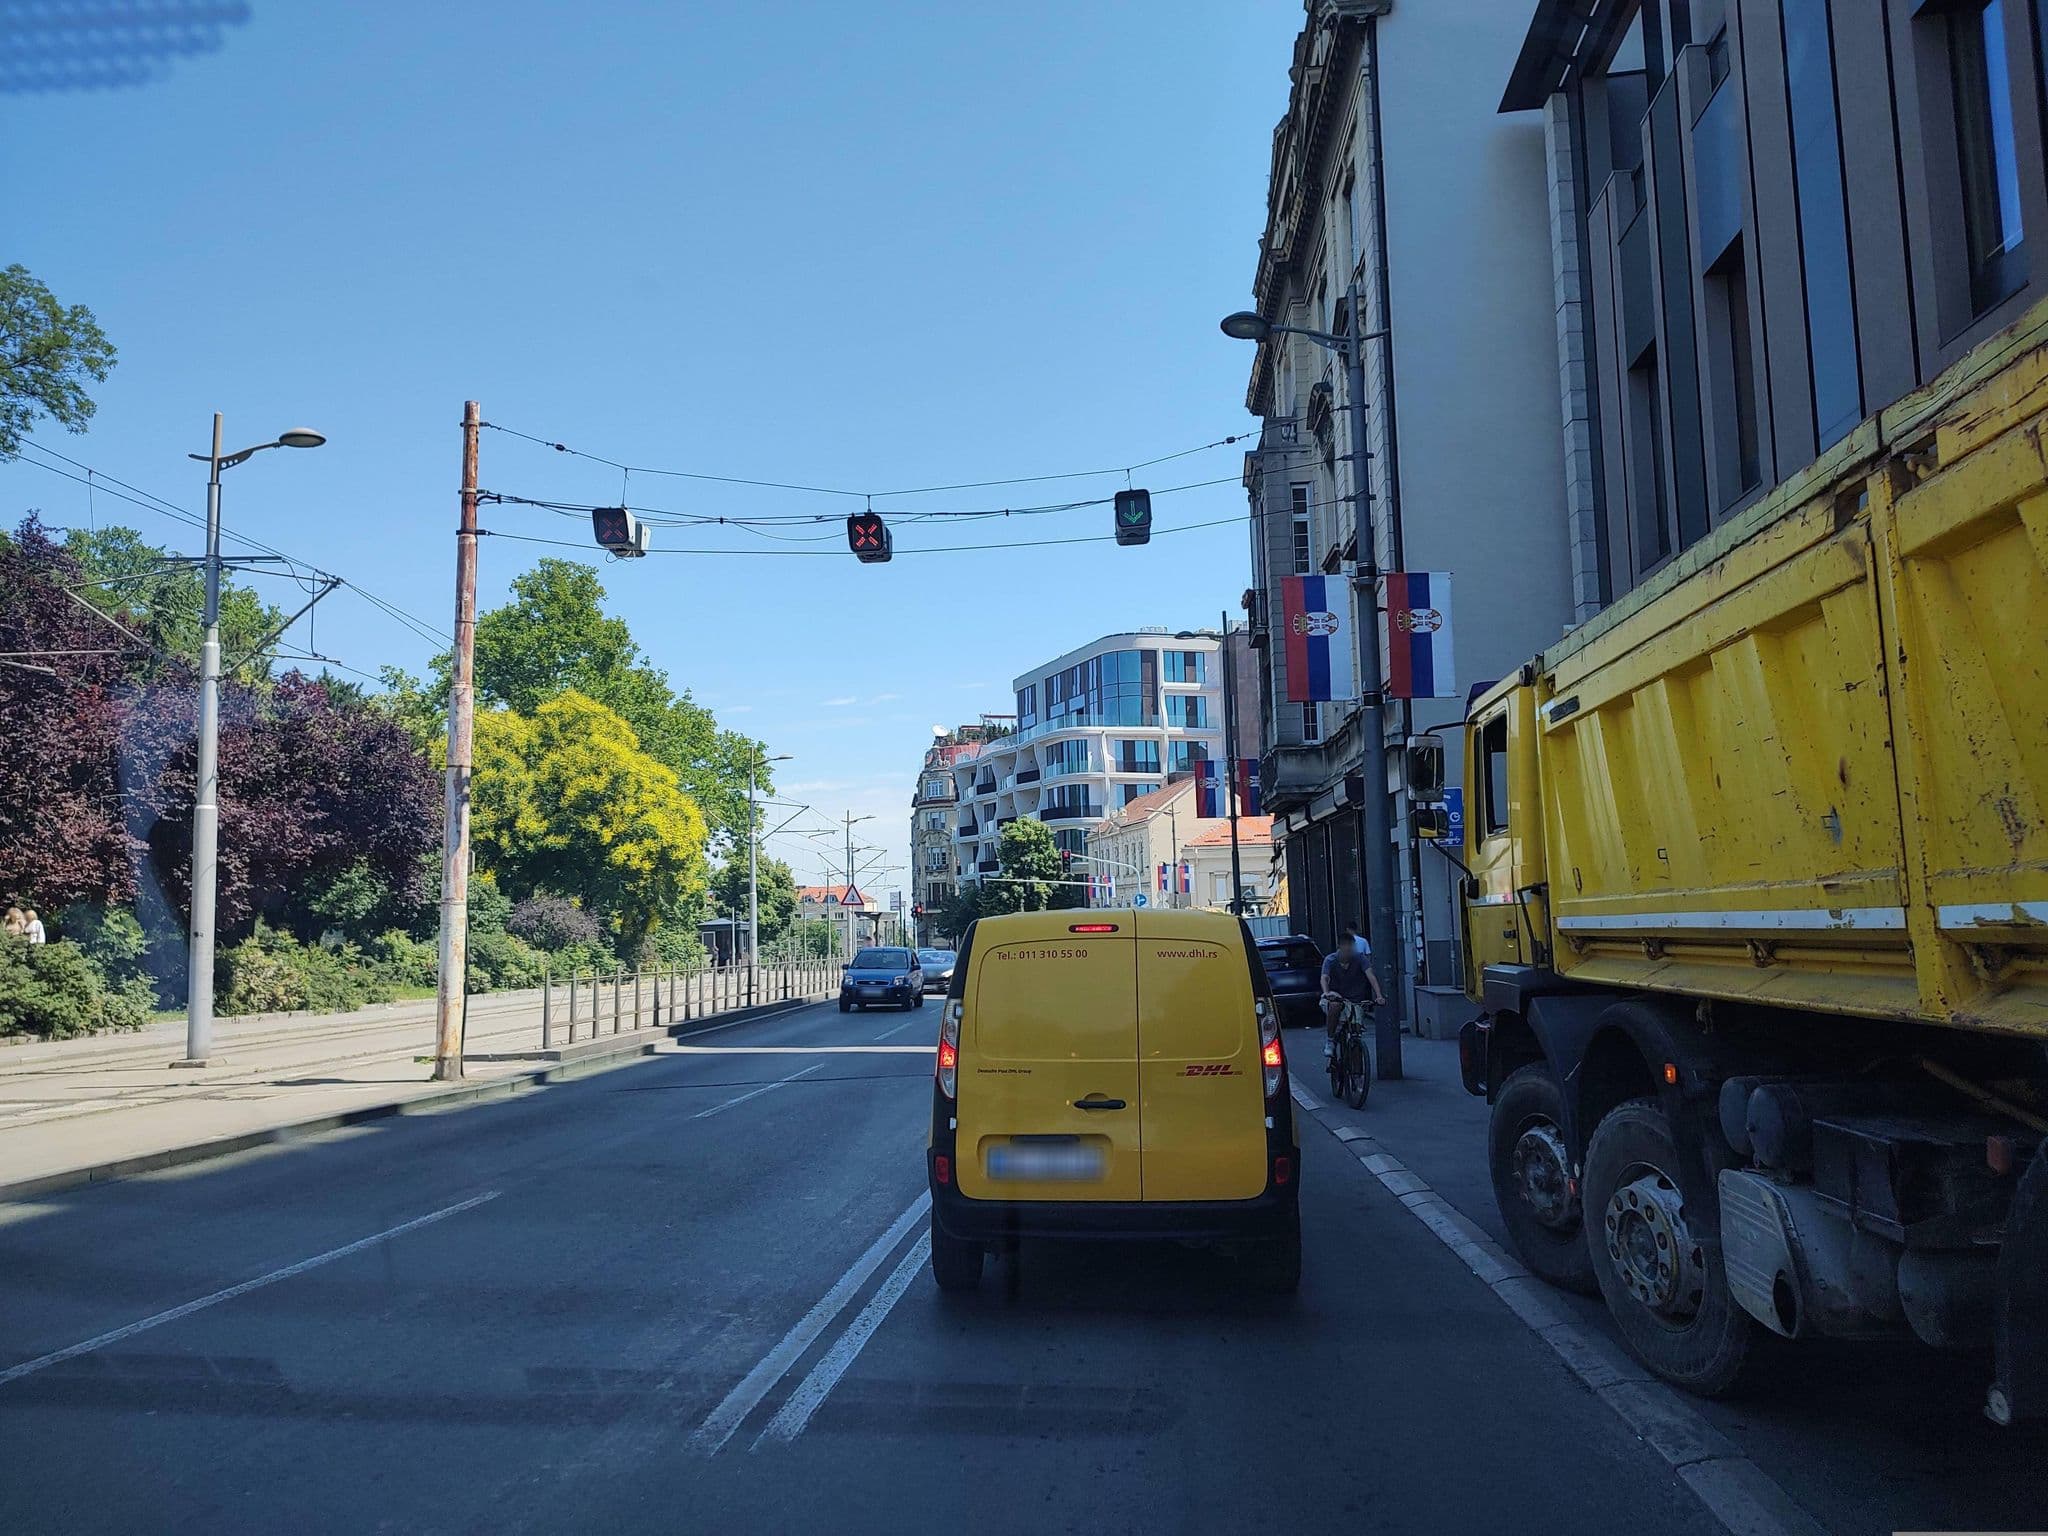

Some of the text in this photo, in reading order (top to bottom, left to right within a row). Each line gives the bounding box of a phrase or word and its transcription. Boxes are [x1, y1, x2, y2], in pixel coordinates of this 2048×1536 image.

[997, 949, 1088, 960] Tel.: 011 310 55 00
[1157, 949, 1217, 958] www.dhl.rs
[1185, 1064, 1233, 1077] DHL
